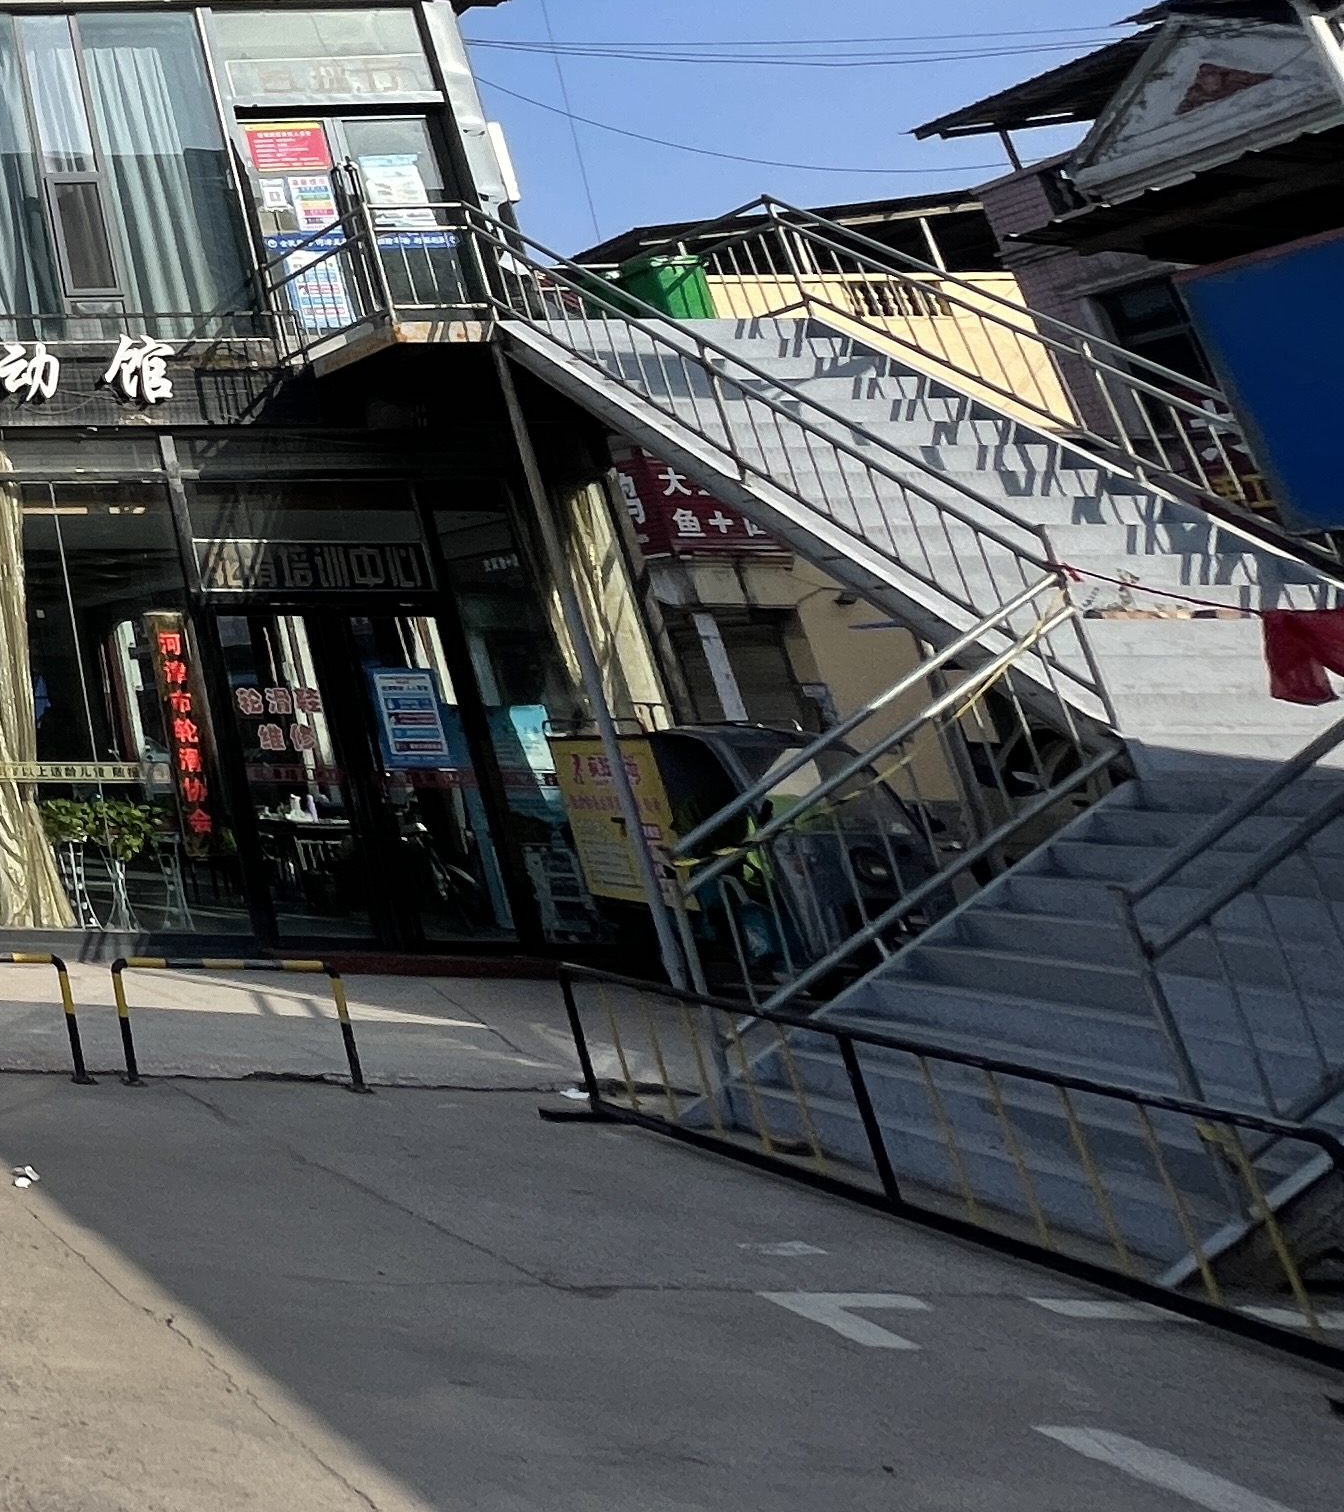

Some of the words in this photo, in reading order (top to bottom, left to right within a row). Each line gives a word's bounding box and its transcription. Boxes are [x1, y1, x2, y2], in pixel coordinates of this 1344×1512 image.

[158, 632, 212, 833] 河津市轮滑协会
[257, 723, 315, 751] 维修
